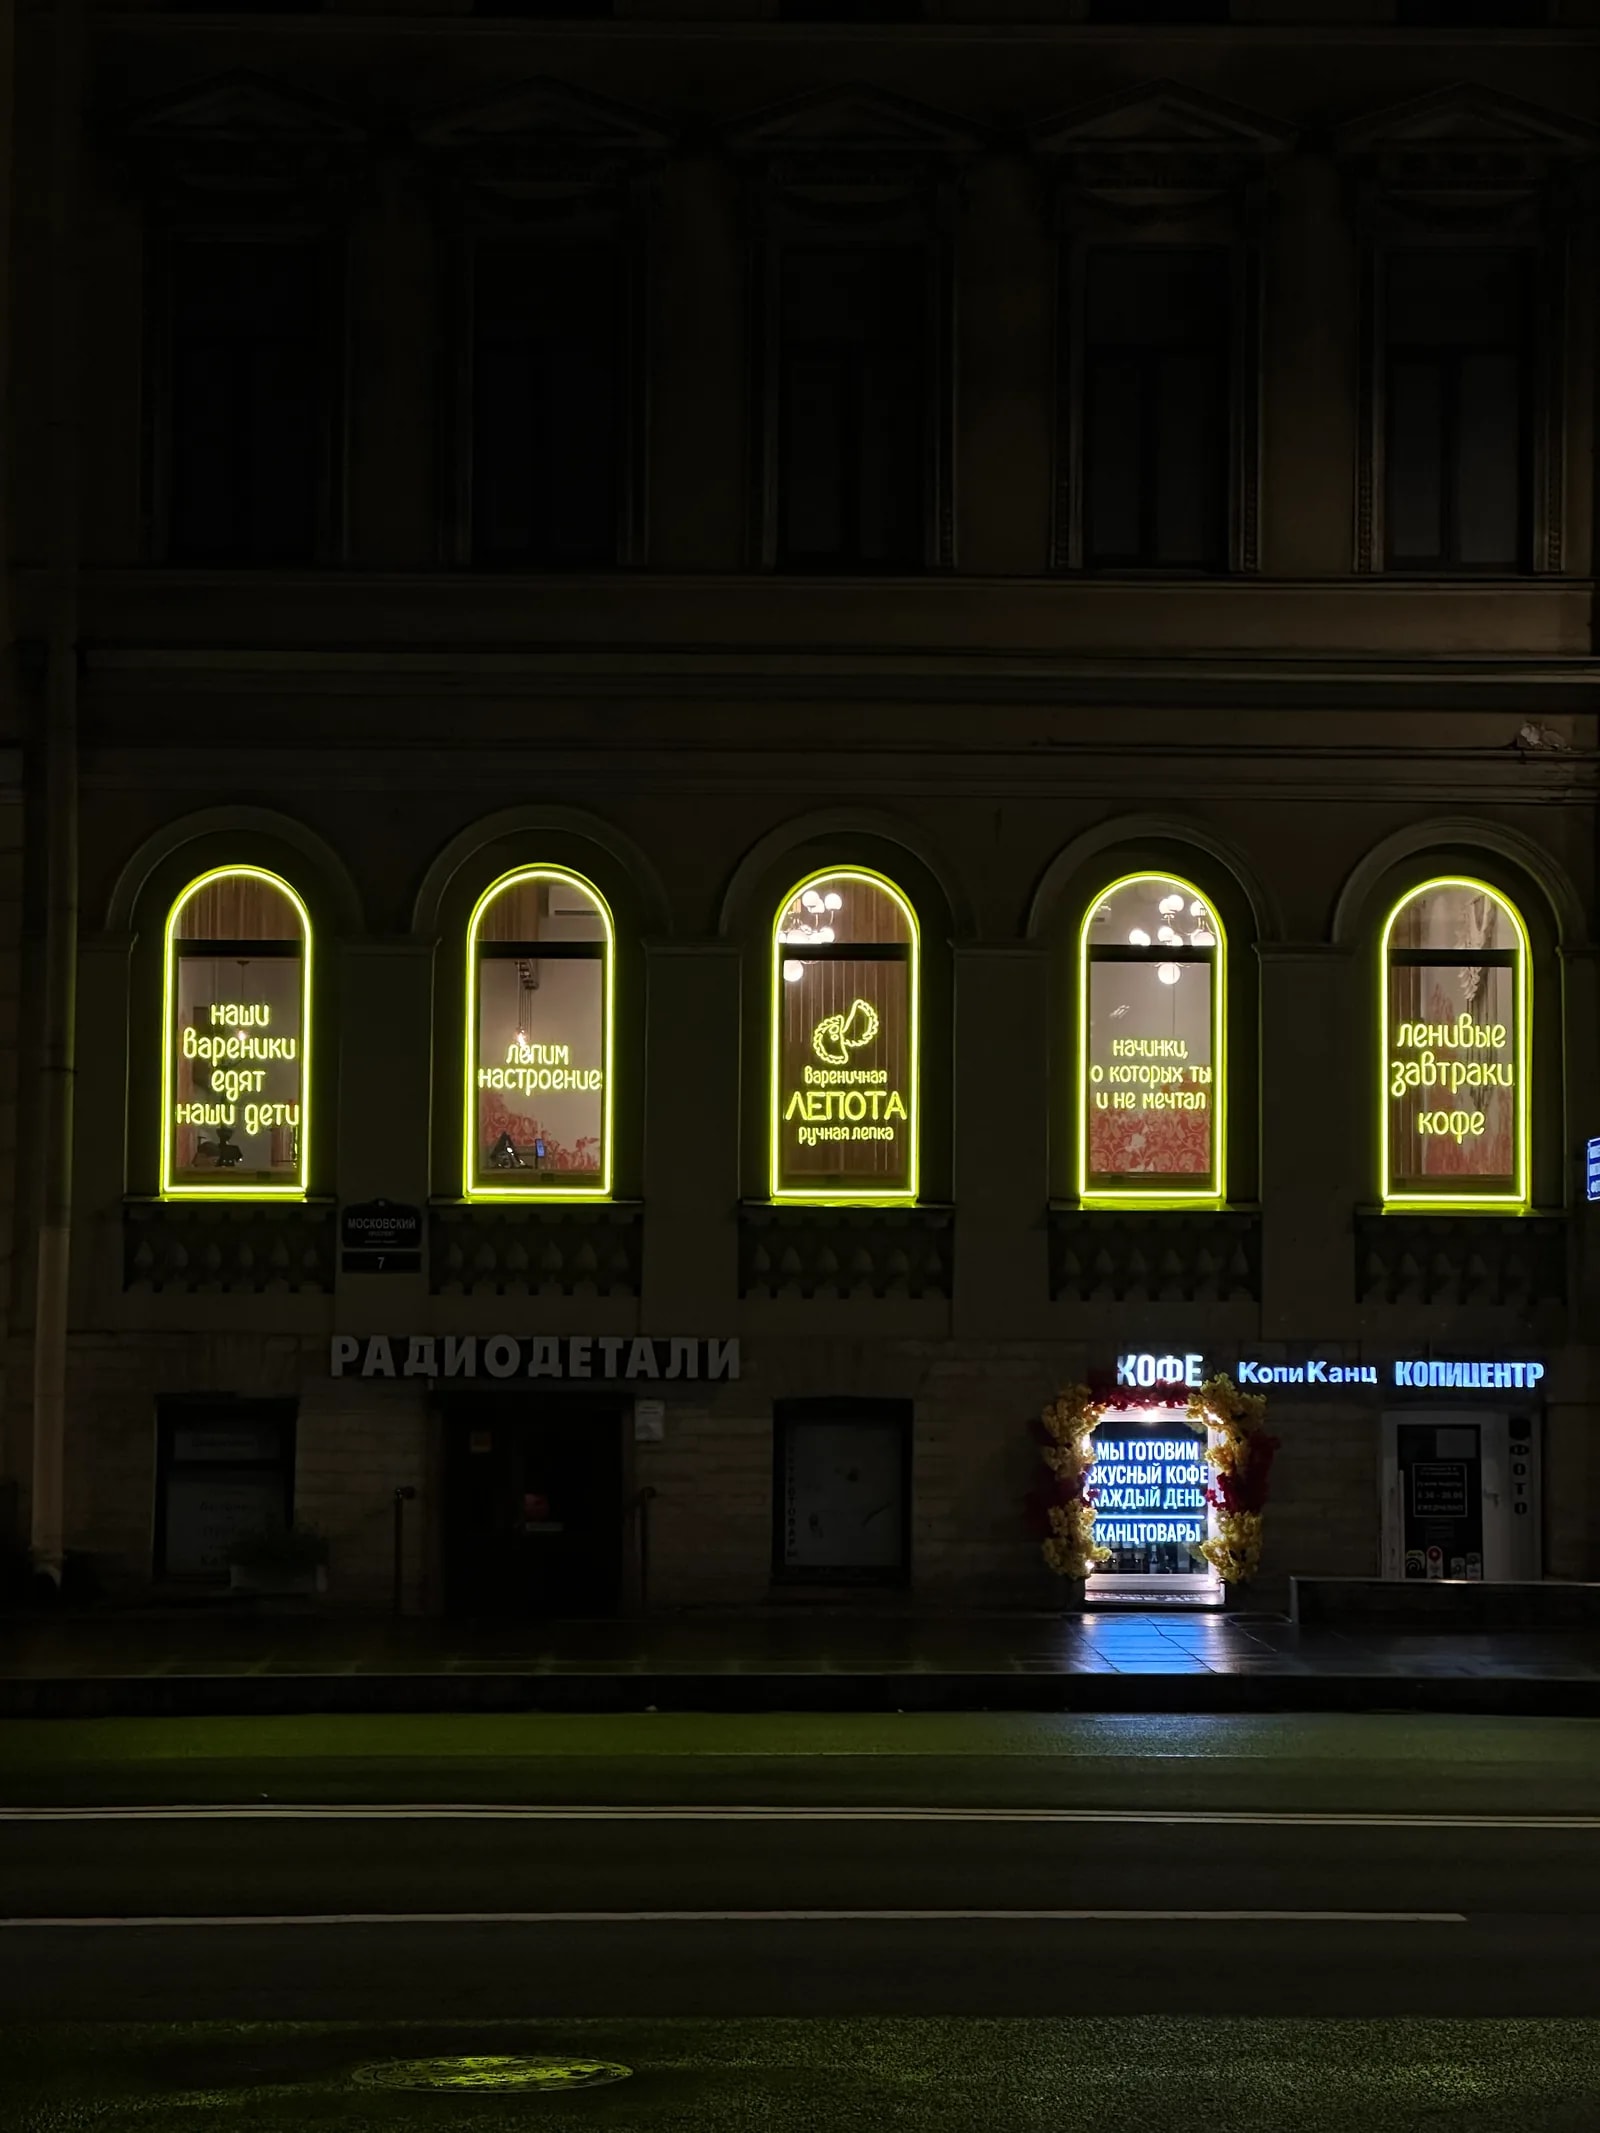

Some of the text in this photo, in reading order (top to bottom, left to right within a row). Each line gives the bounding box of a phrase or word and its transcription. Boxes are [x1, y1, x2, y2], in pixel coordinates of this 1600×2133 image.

[211, 1004, 270, 1026] наши
[1396, 1012, 1507, 1048] ленивые
[183, 1027, 296, 1067] вареники
[506, 1044, 569, 1065] лепим
[1113, 1039, 1188, 1059] начинки,
[211, 1070, 266, 1101] едят
[804, 1065, 888, 1088] вареничная
[1090, 1065, 1212, 1089] о которых ты
[1390, 1051, 1514, 1097] завтраки
[785, 1091, 907, 1120] ЛЕПОТА
[1096, 1092, 1207, 1109] и не мечтал
[176, 1103, 299, 1135] наши дети
[1418, 1110, 1486, 1144] кофе
[798, 1126, 894, 1146] ручная лепка
[347, 1216, 416, 1230] МОСКОВСКИЙ
[377, 1256, 386, 1271] 7
[330, 1334, 741, 1379] РАДИОДЕТАЛИ
[1116, 1354, 1204, 1387] КОФЕ
[1394, 1361, 1545, 1388] КОПИЦЕНТР
[1097, 1441, 1200, 1461] МЫ ГОТОВИМ
[1088, 1462, 1209, 1486] ВКУСНЫЙ КОФЕ
[1509, 1444, 1530, 1515] ФОТО
[1163, 1488, 1207, 1510] ДЕНЬ
[1095, 1523, 1202, 1545] КАНЦТОВАРЫ
